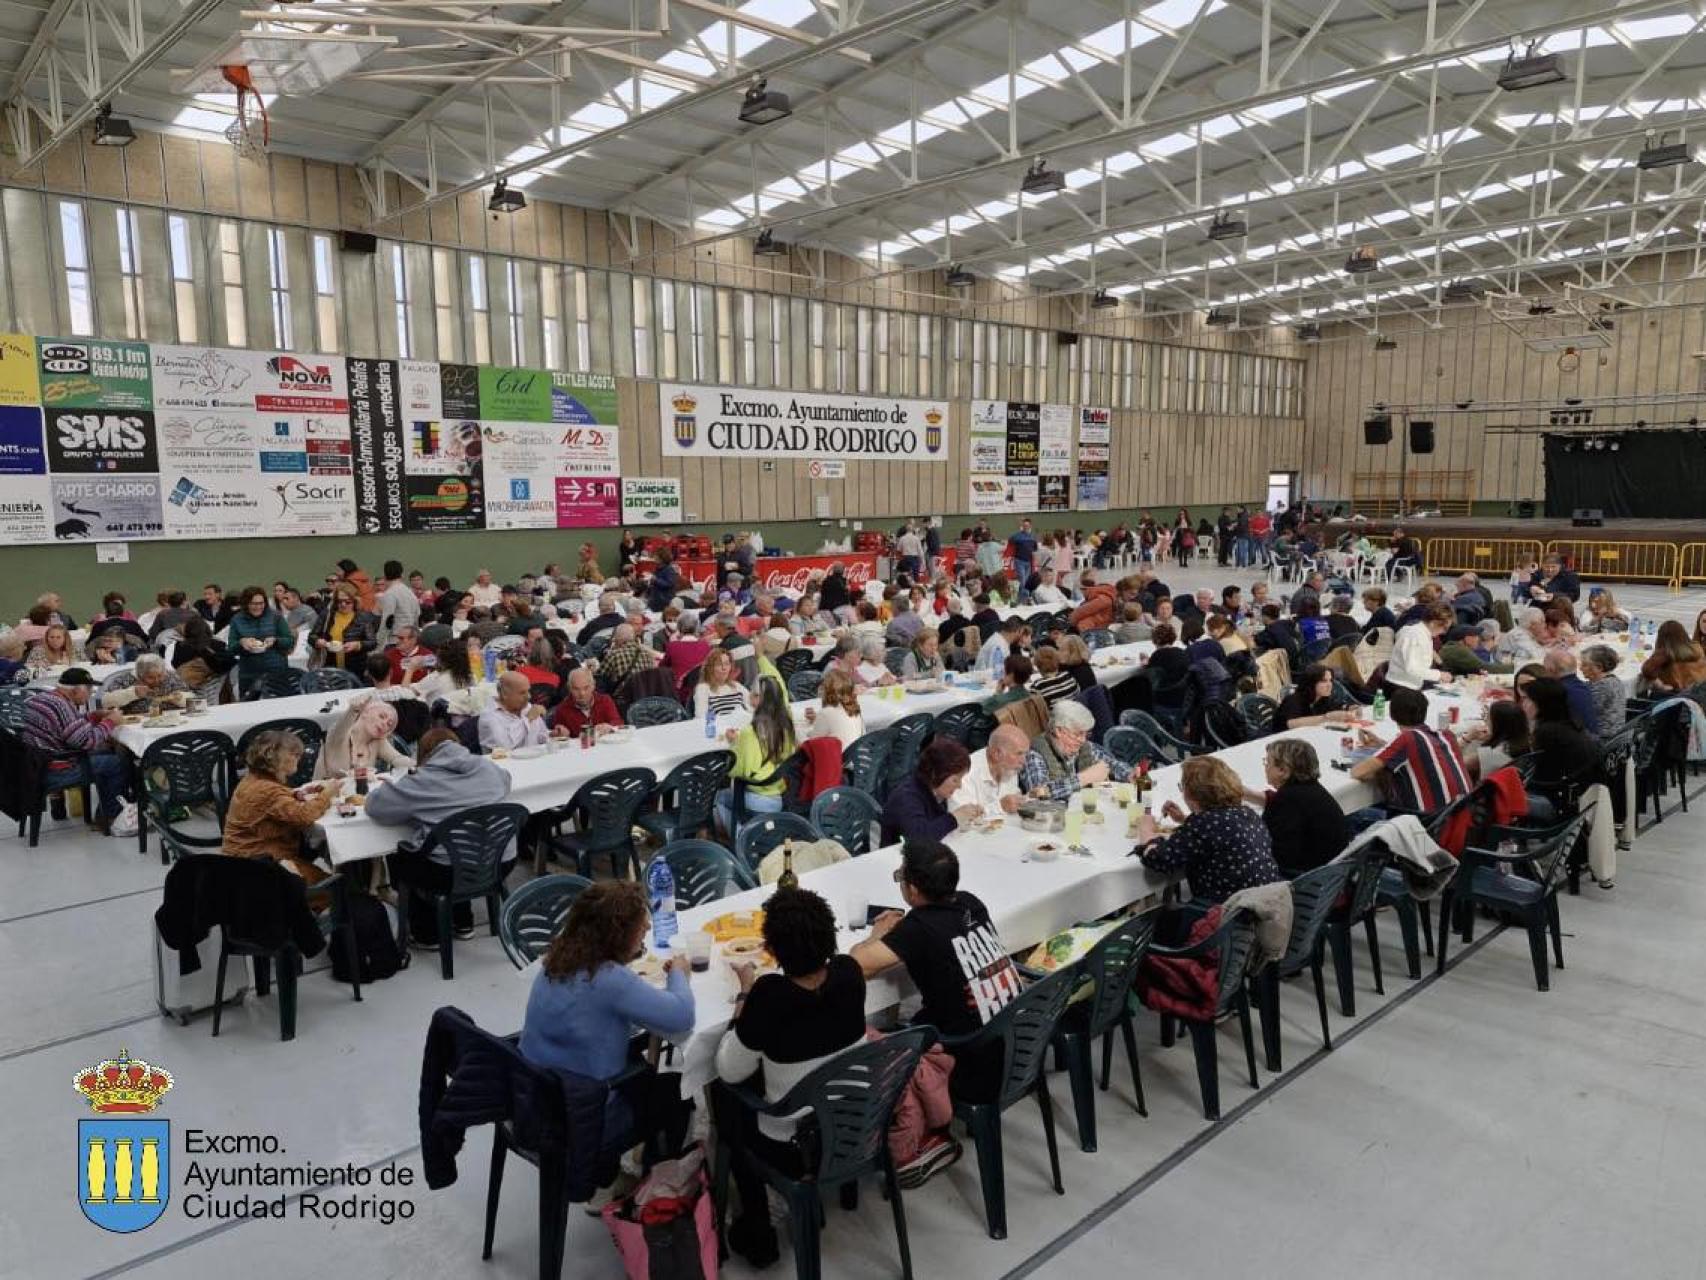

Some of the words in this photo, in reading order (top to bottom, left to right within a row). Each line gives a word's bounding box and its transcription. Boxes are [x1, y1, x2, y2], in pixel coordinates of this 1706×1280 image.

[92, 346, 124, 362] 89.1
[126, 348, 146, 364] fm
[281, 371, 332, 384] NOVA
[496, 371, 536, 394] Cid
[720, 393, 782, 418] Excmo.
[788, 399, 887, 423] Ayuntamiento
[890, 404, 907, 423] de
[708, 421, 809, 450] CIUDAD
[815, 426, 917, 454] RODRIGO
[56, 483, 93, 497] ARTE
[96, 484, 156, 497] CHARRO
[296, 482, 346, 499] Sacir
[389, 483, 403, 529] SEGUROS
